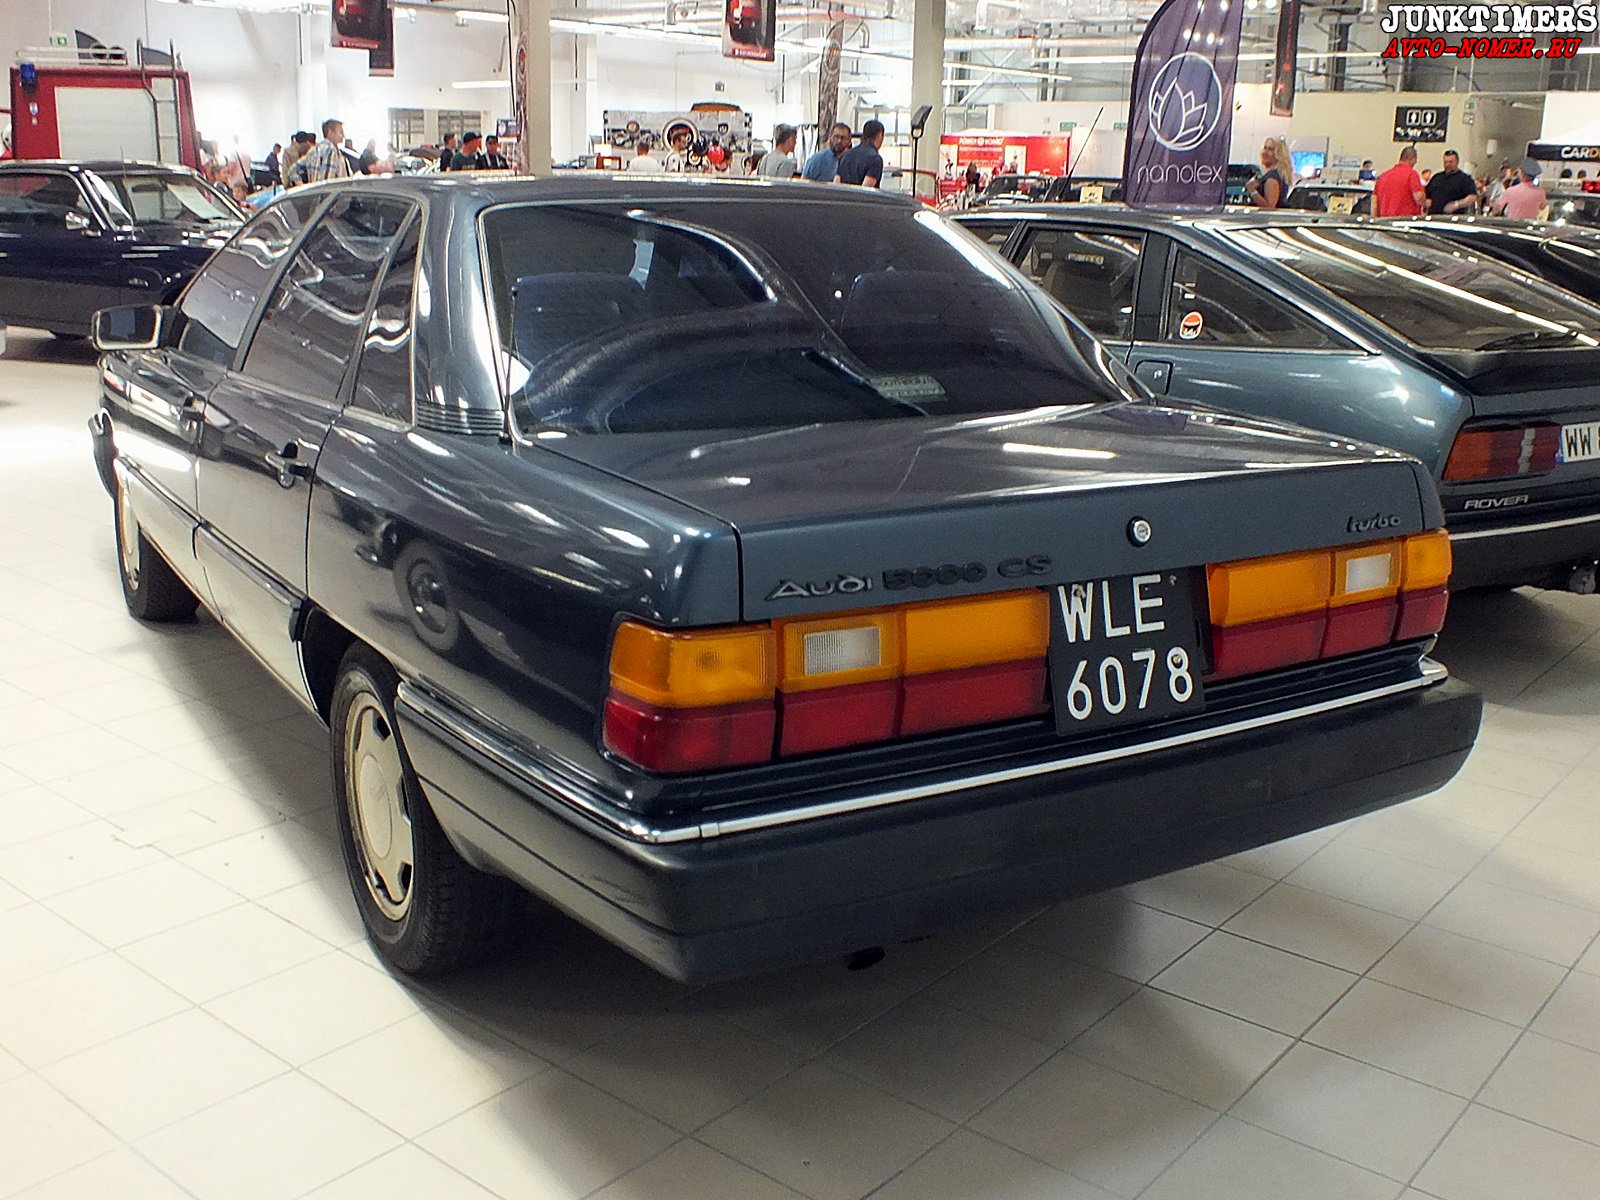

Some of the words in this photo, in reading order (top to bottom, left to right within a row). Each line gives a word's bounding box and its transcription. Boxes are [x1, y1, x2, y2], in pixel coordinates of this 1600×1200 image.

[1561, 147, 1600, 159] CARD
[1137, 160, 1223, 184] nanolex
[1565, 427, 1592, 457] WW
[1464, 494, 1529, 510] ROVER
[1345, 512, 1401, 533] turbo
[882, 561, 988, 590] 5000
[997, 554, 1052, 578] CS
[1057, 574, 1165, 643] WLE
[1067, 646, 1193, 720] 6078
